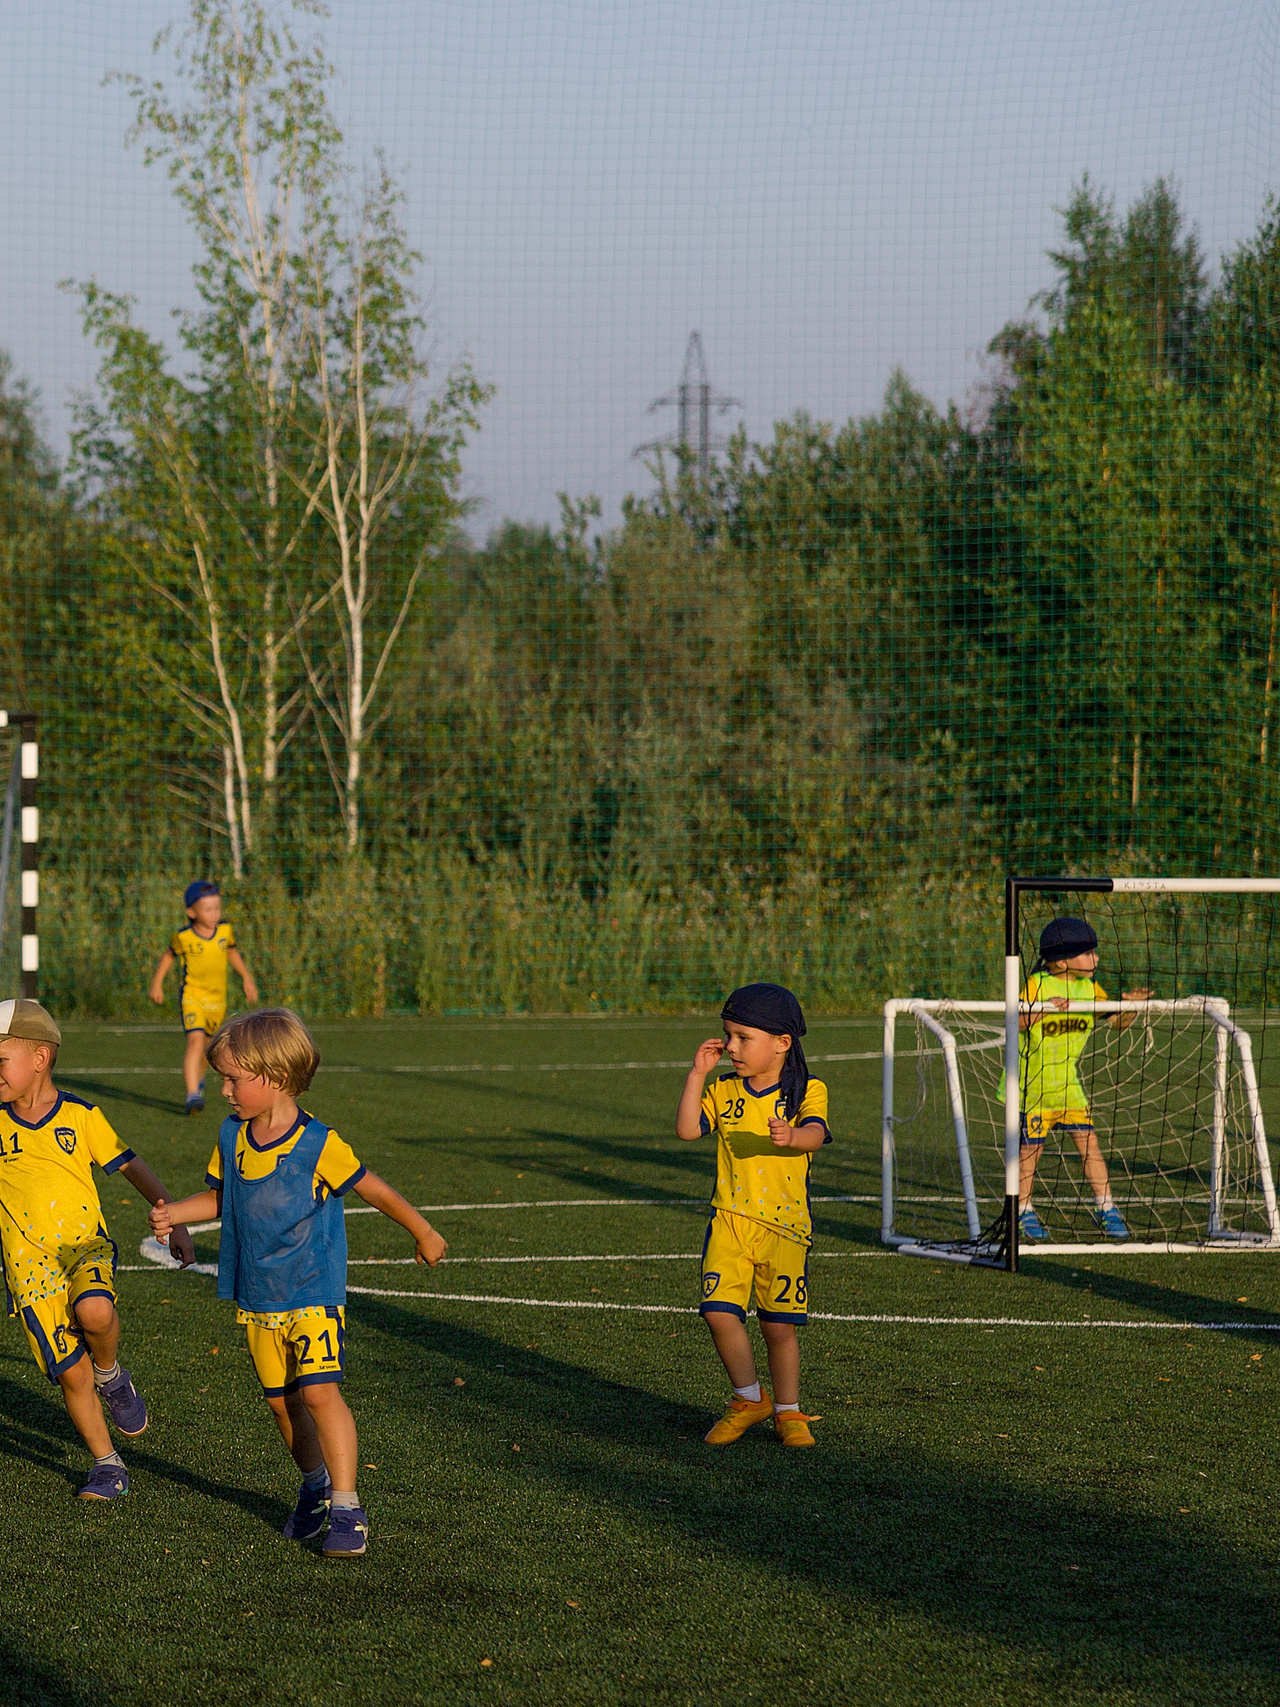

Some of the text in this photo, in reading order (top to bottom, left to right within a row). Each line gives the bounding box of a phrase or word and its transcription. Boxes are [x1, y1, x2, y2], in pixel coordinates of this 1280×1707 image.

[720, 1098, 745, 1118] 28
[86, 1267, 108, 1285] 1
[774, 1275, 806, 1304] 28
[296, 1330, 336, 1365] 21
